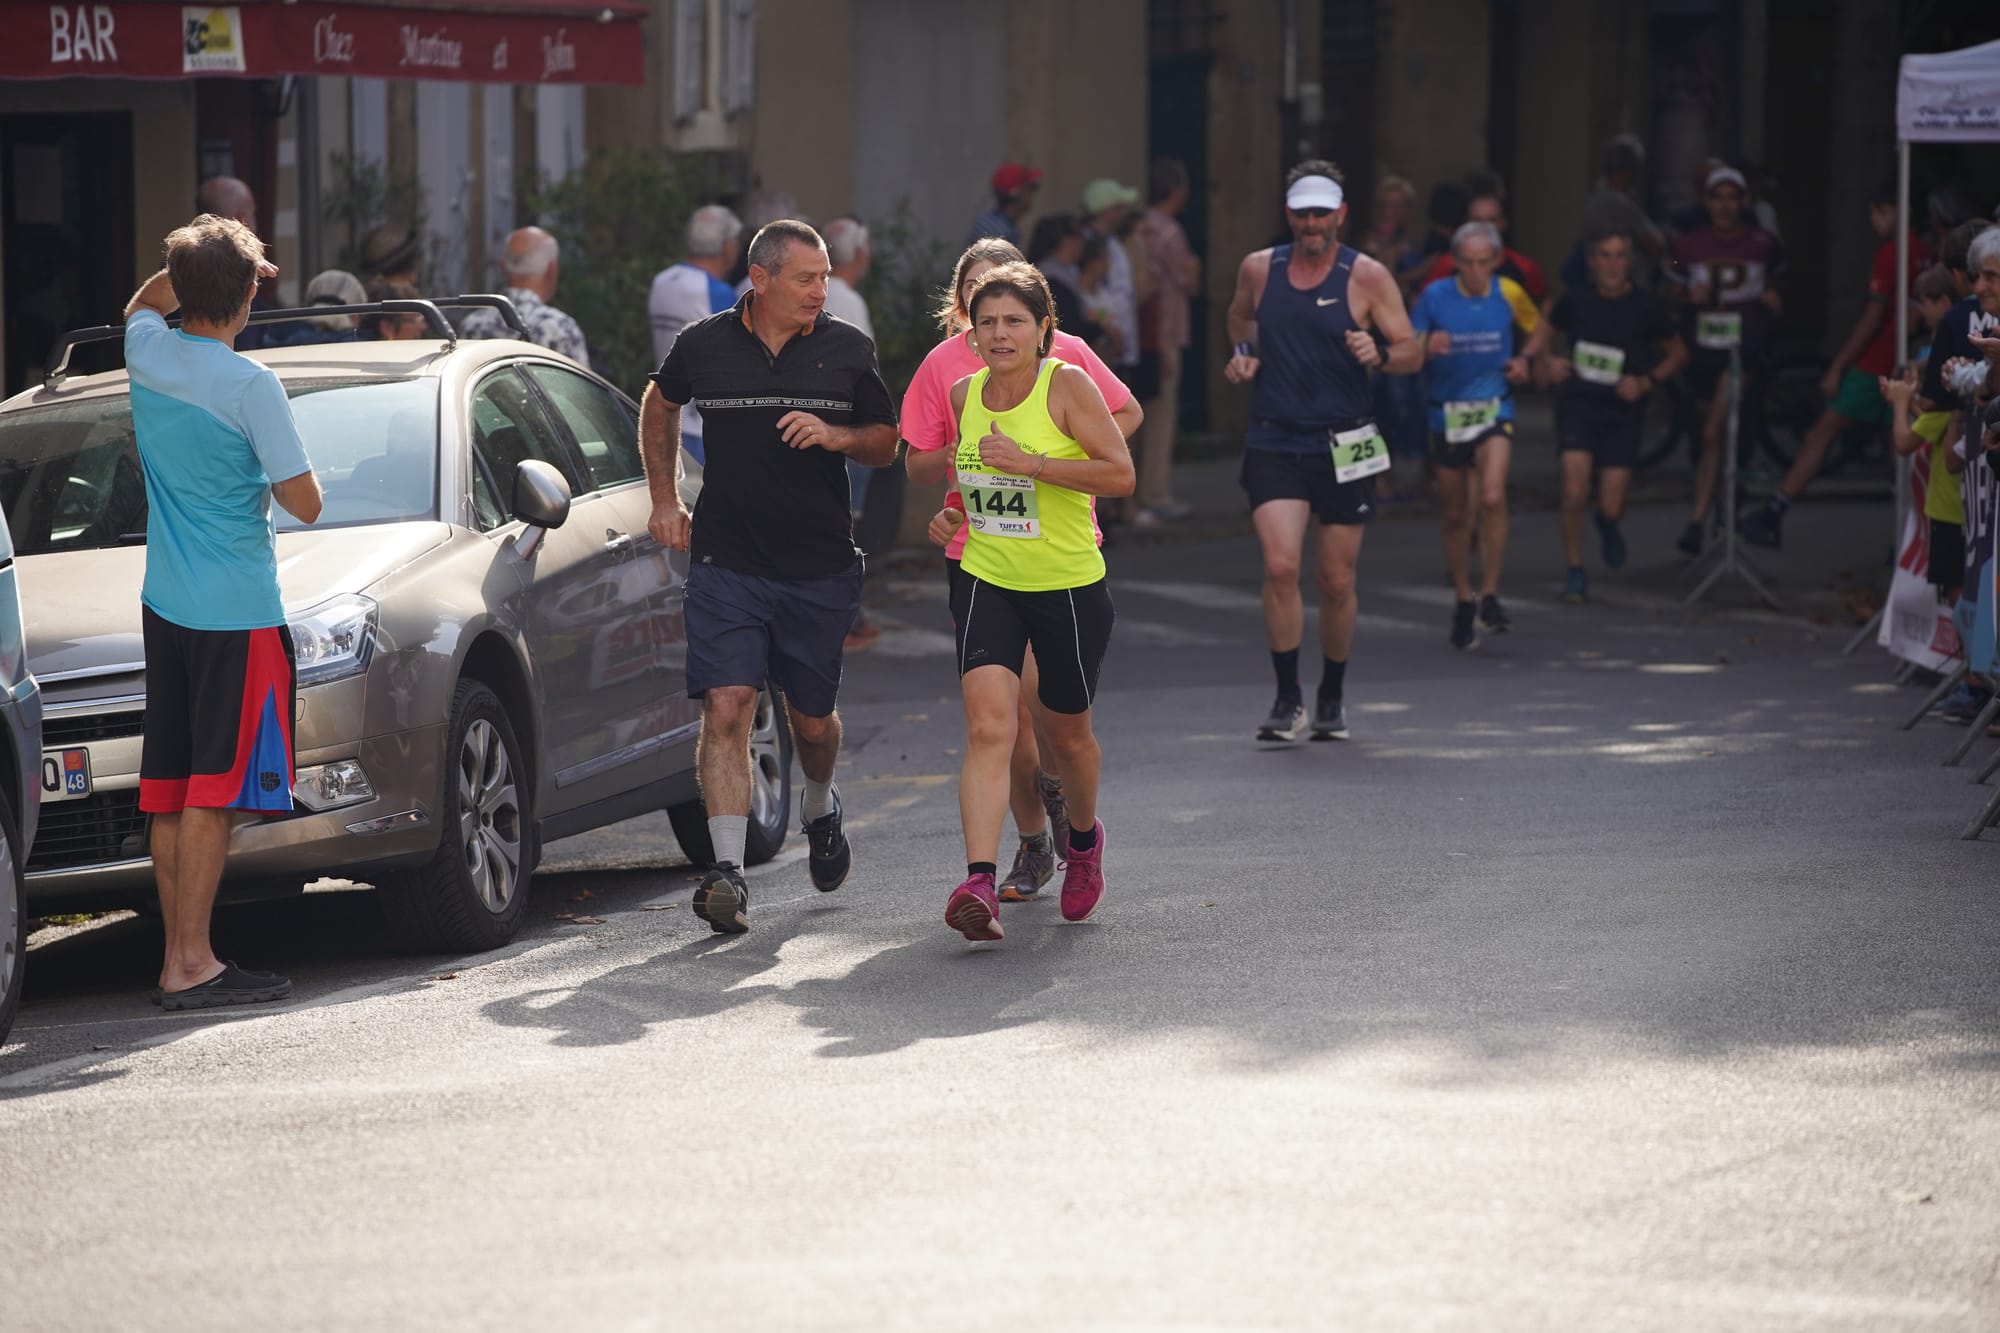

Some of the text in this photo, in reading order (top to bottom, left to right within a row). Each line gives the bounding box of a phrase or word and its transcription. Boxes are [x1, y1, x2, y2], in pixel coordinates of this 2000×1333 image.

[50, 5, 117, 62] BAR
[314, 14, 354, 63] Chez
[1350, 439, 1375, 463] 25
[969, 489, 1027, 516] 144
[67, 774, 85, 790] 48
